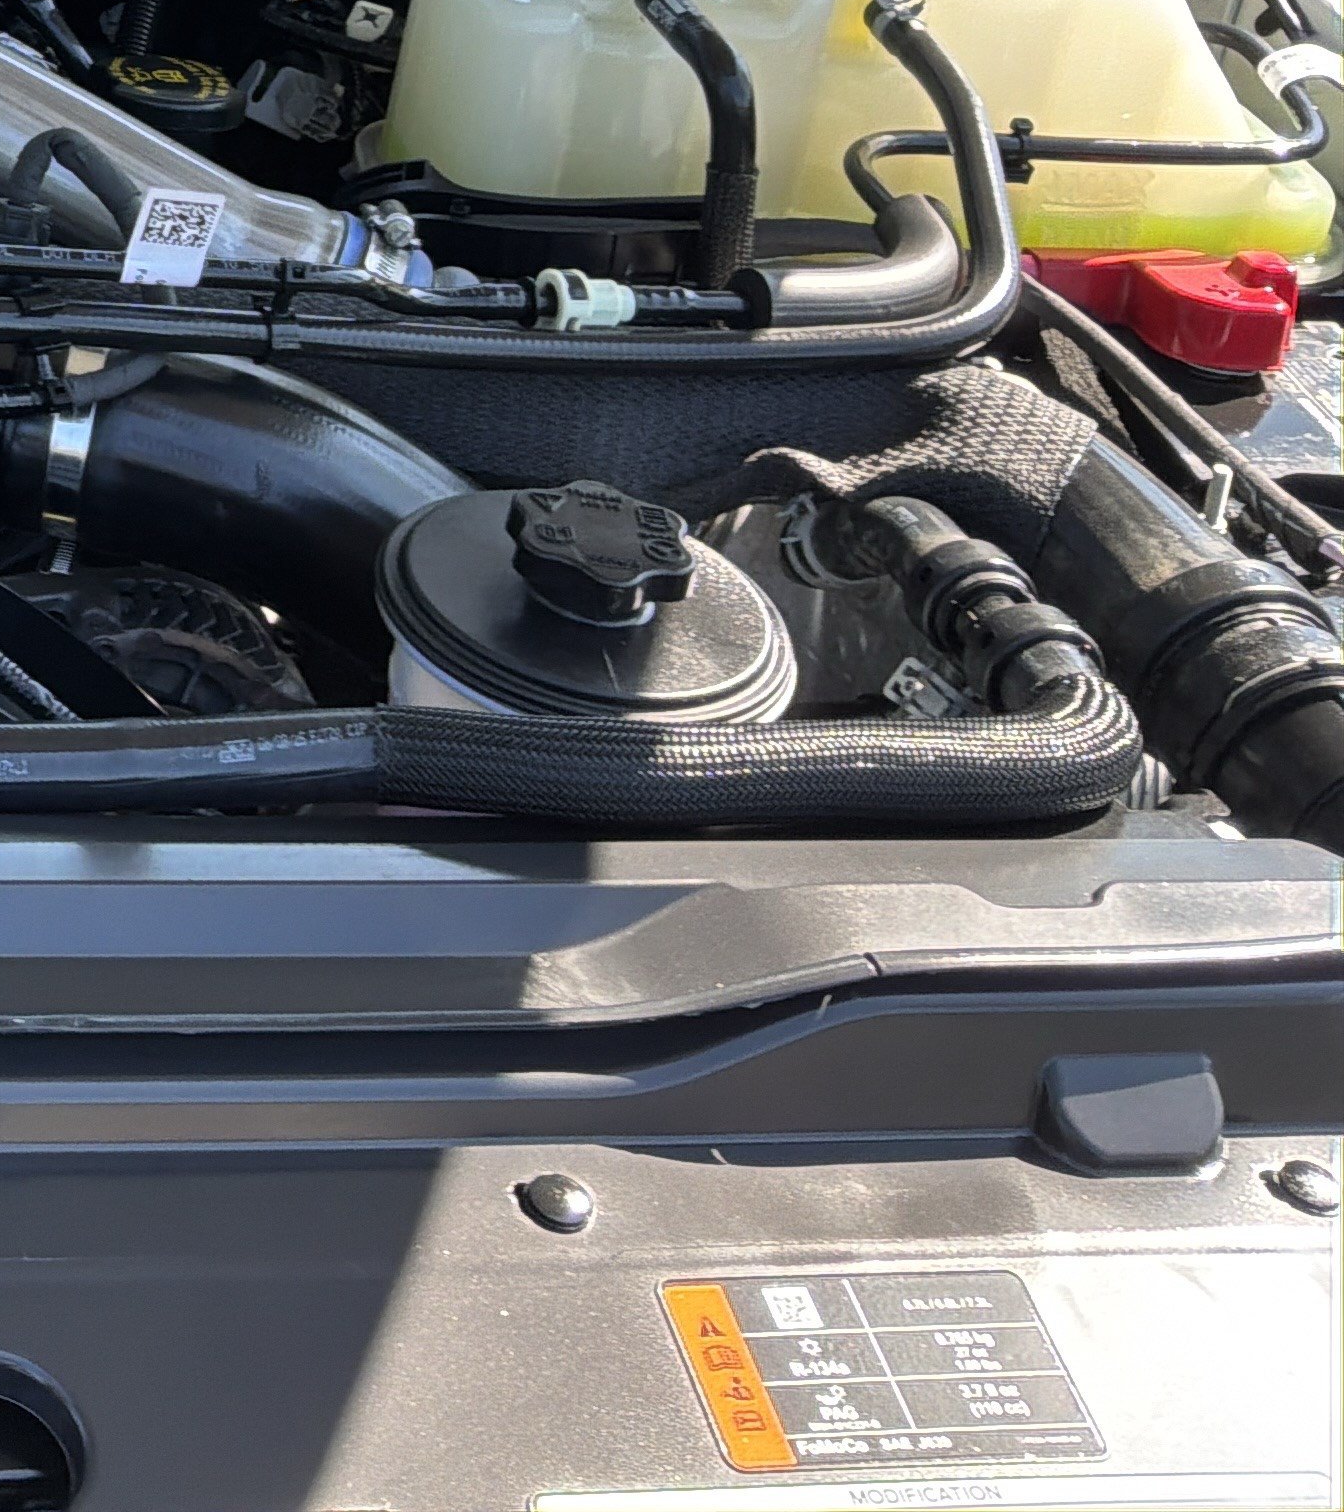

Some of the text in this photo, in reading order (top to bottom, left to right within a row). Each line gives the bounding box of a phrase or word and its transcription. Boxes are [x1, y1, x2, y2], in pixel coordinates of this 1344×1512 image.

[972, 1331, 995, 1348] kg
[789, 1360, 851, 1377] R-134a
[999, 1384, 1021, 1397] oz
[820, 1405, 859, 1420] PAG
[795, 1439, 869, 1455] FoMoCo
[849, 1486, 1002, 1505] MODIFICATION
